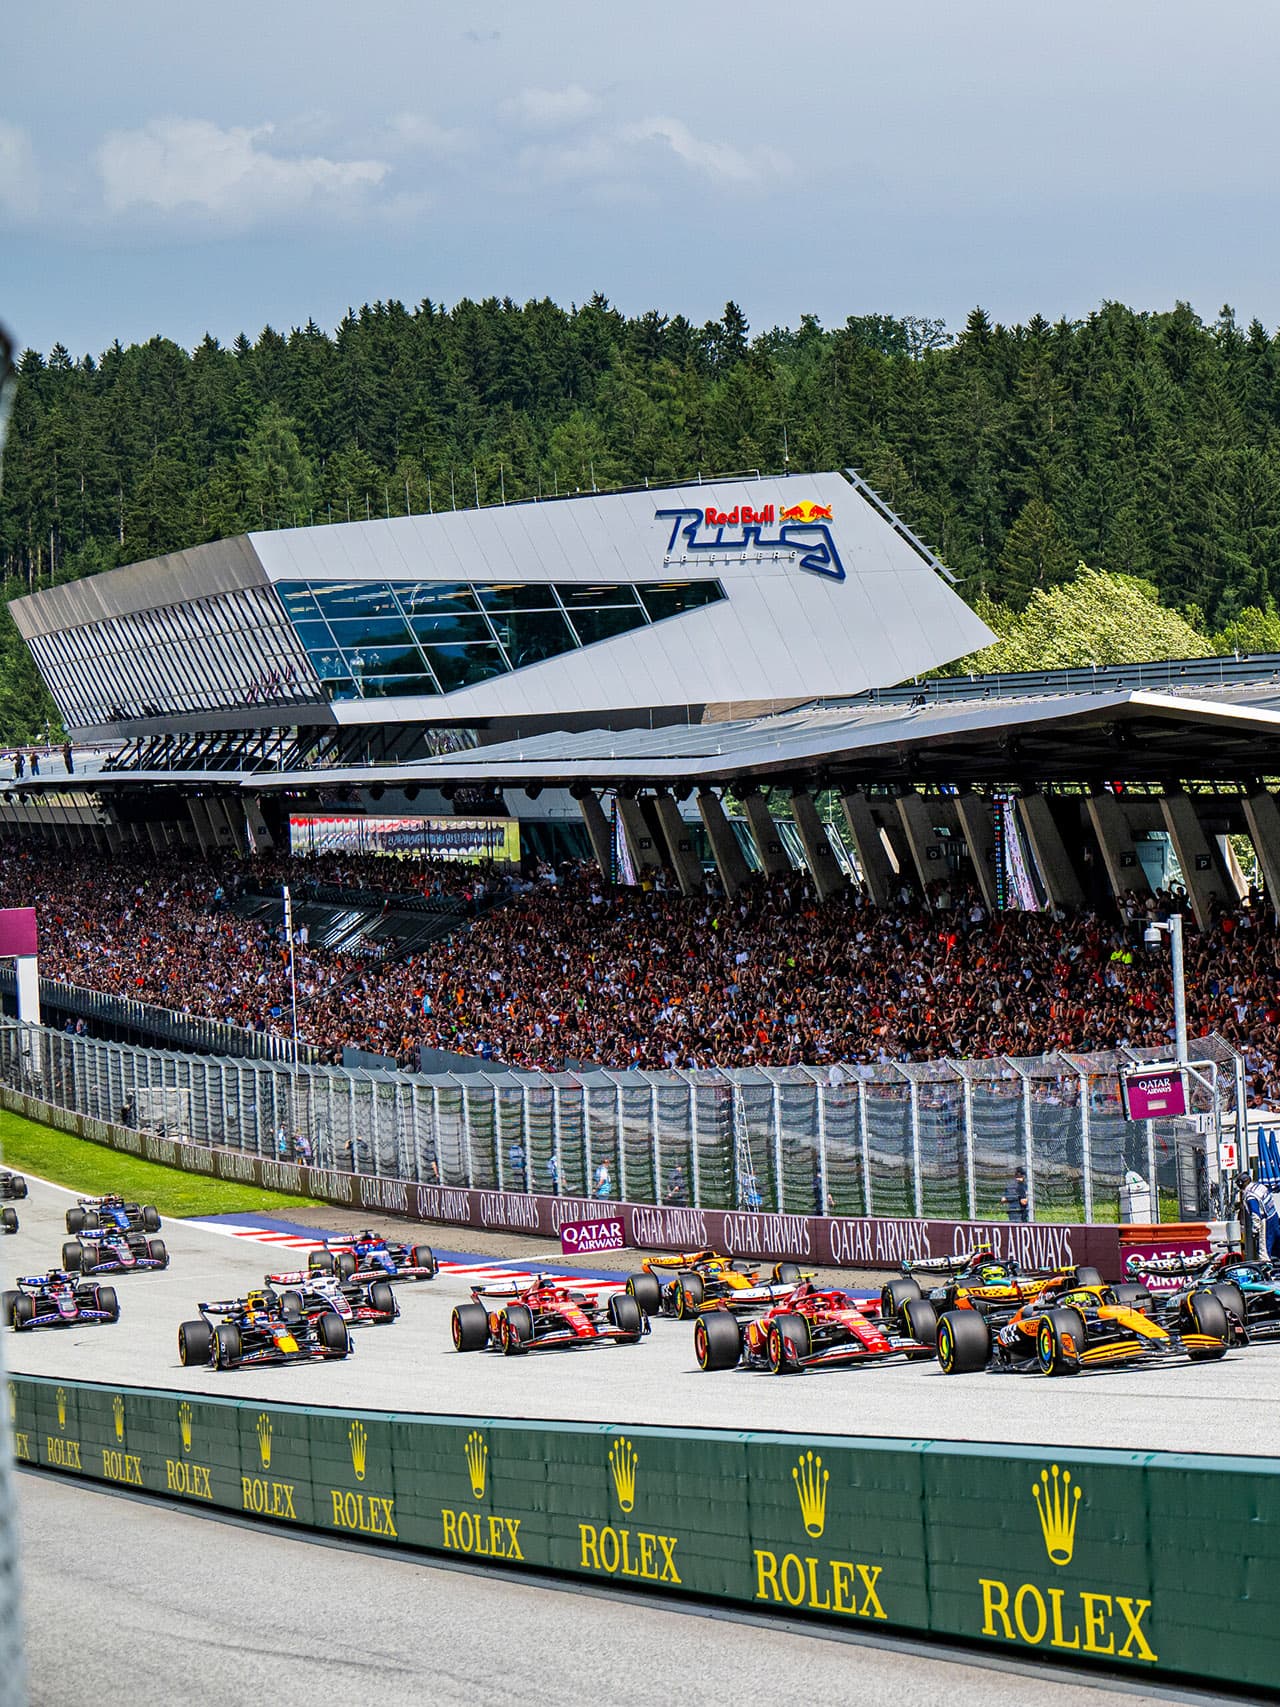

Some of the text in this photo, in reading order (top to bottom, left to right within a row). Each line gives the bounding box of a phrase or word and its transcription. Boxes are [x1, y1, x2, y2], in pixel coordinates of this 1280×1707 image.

[705, 504, 775, 525] Red Bull
[664, 551, 797, 564] SPIELBERG
[1138, 1078, 1171, 1091] QATAR
[360, 1177, 409, 1211] QATAR AIRWAYS
[417, 1186, 471, 1221] QATAR AIRWAYS
[480, 1193, 539, 1229] QATAR AIRWAYS
[563, 1223, 622, 1244] QATAR
[578, 1237, 623, 1251] AIRWAYS
[632, 1207, 708, 1247] QATAR AIRWAYS
[723, 1214, 811, 1255] QATAR AIRWAYS
[830, 1220, 931, 1264] QATAR AIRWAYS
[1007, 1226, 1073, 1271] AIRWAYS
[47, 1436, 82, 1469] ROLEX
[102, 1450, 144, 1485] ROLEX
[166, 1460, 213, 1499] ROLEX
[241, 1476, 297, 1519] ROLEX
[330, 1490, 399, 1537] ROLEX
[441, 1509, 525, 1561] ROLEX
[578, 1523, 682, 1584] ROLEX
[753, 1549, 888, 1620] ROLEX
[978, 1578, 1158, 1662] ROLEX
